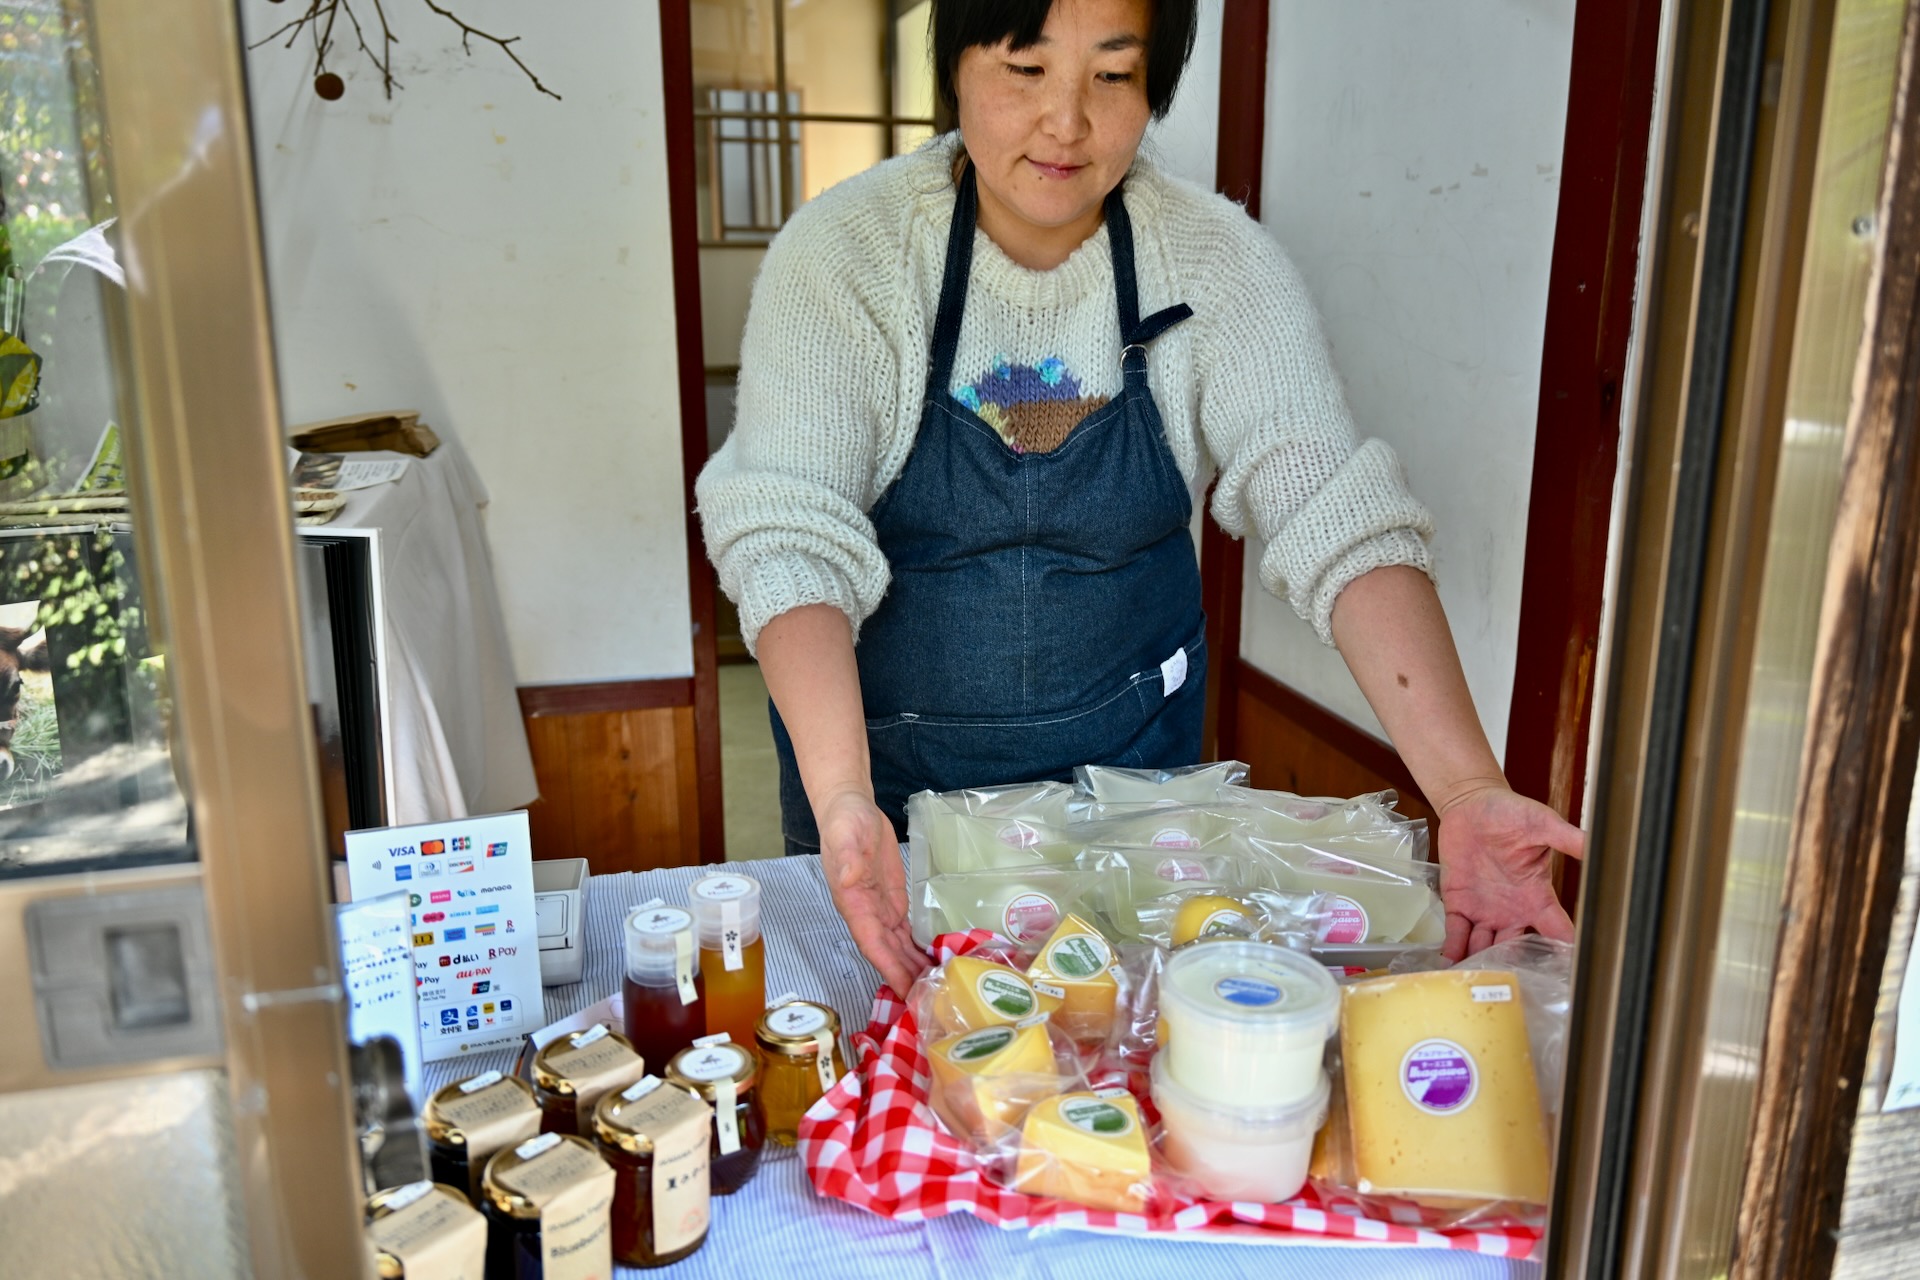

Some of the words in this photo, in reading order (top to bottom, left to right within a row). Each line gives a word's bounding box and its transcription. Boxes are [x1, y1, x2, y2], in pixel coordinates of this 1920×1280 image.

[388, 845, 416, 857] VISA
[480, 884, 512, 894] manaca
[1332, 917, 1361, 927] gawa
[498, 946, 517, 957] Pay
[456, 970, 474, 979] au
[475, 967, 492, 976] PAY
[424, 976, 440, 984] Pay
[440, 1025, 462, 1036] 支付宝
